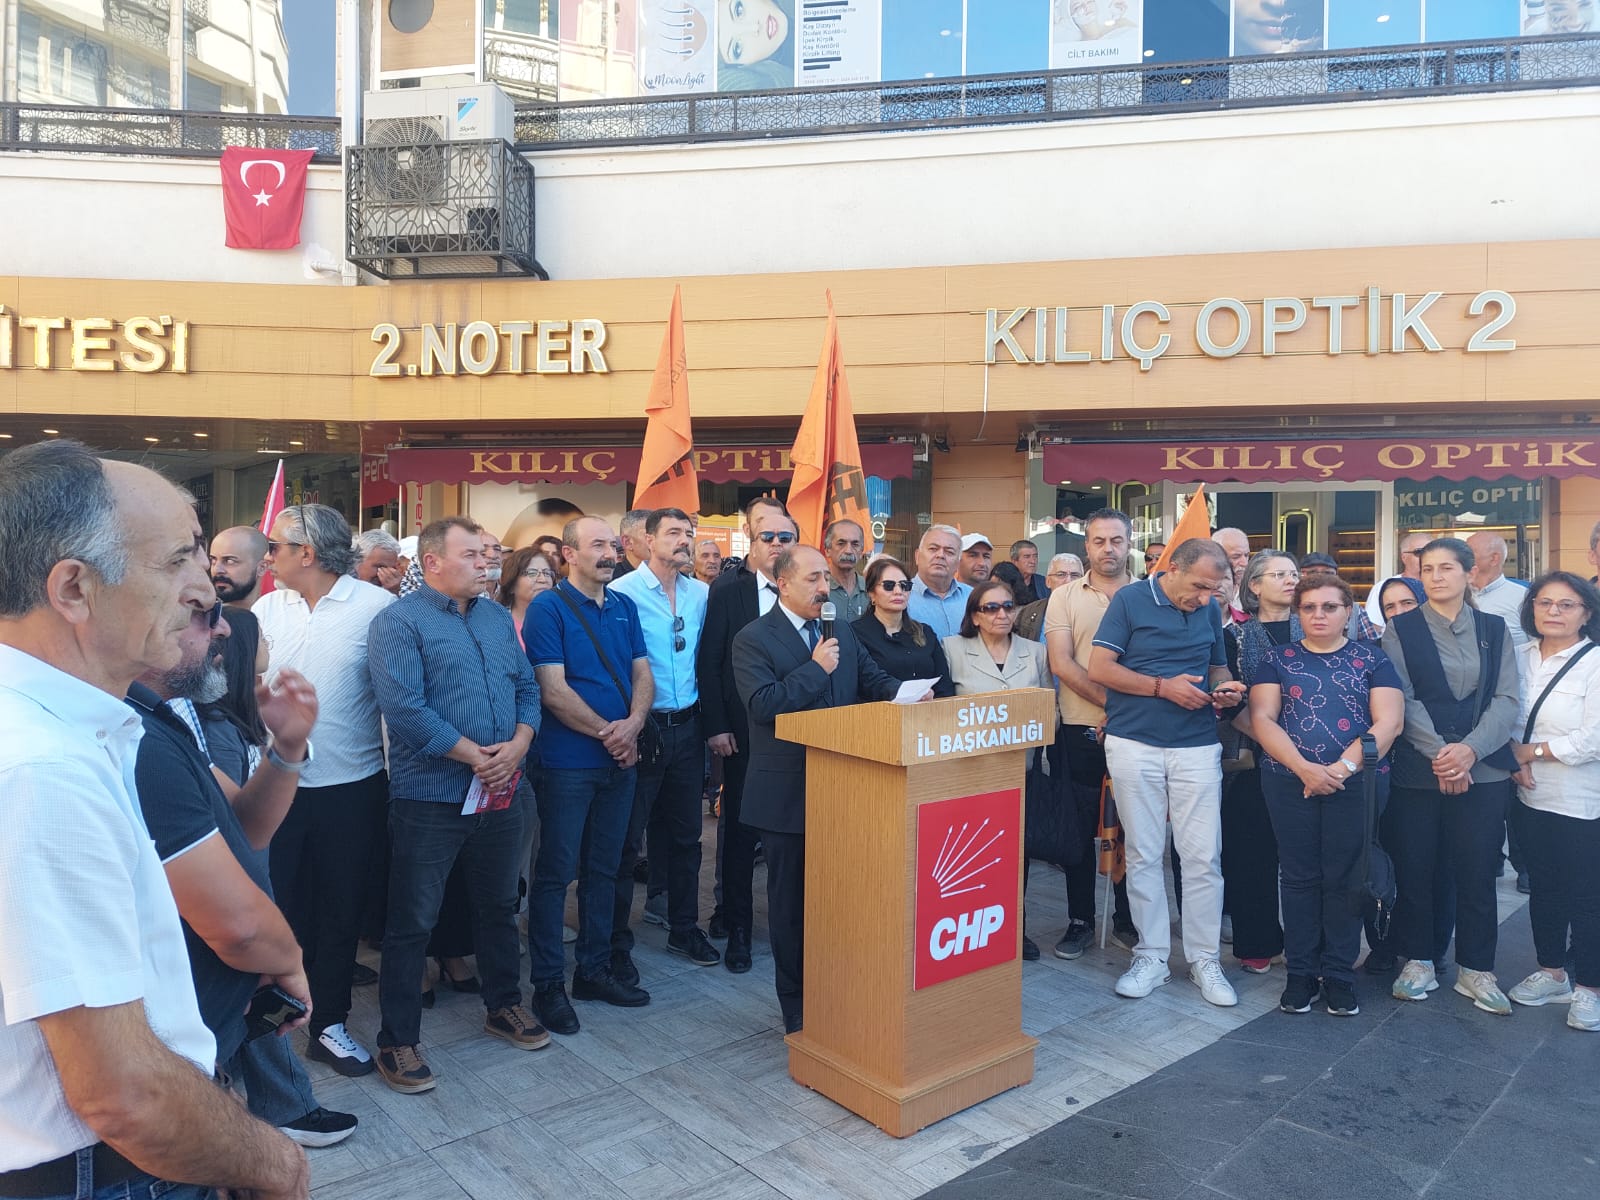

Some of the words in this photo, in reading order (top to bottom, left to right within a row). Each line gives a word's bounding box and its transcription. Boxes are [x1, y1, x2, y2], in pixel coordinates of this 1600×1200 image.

[1067, 48, 1086, 59] CİLT
[1088, 47, 1119, 58] BAKIMI
[985, 300, 1172, 372] KILIÇ
[1195, 285, 1444, 358] OPTİK
[1466, 289, 1516, 354] 2
[369, 318, 610, 377] 2.NOTER
[469, 451, 617, 480] KILIÇ
[1159, 444, 1345, 478] KILIÇ
[1400, 489, 1465, 508] KILIÇ
[957, 702, 1008, 728] SİVAS
[917, 732, 936, 757] İL
[939, 719, 1043, 753] BAŞKANLIĞI
[929, 904, 1005, 961] CHP
